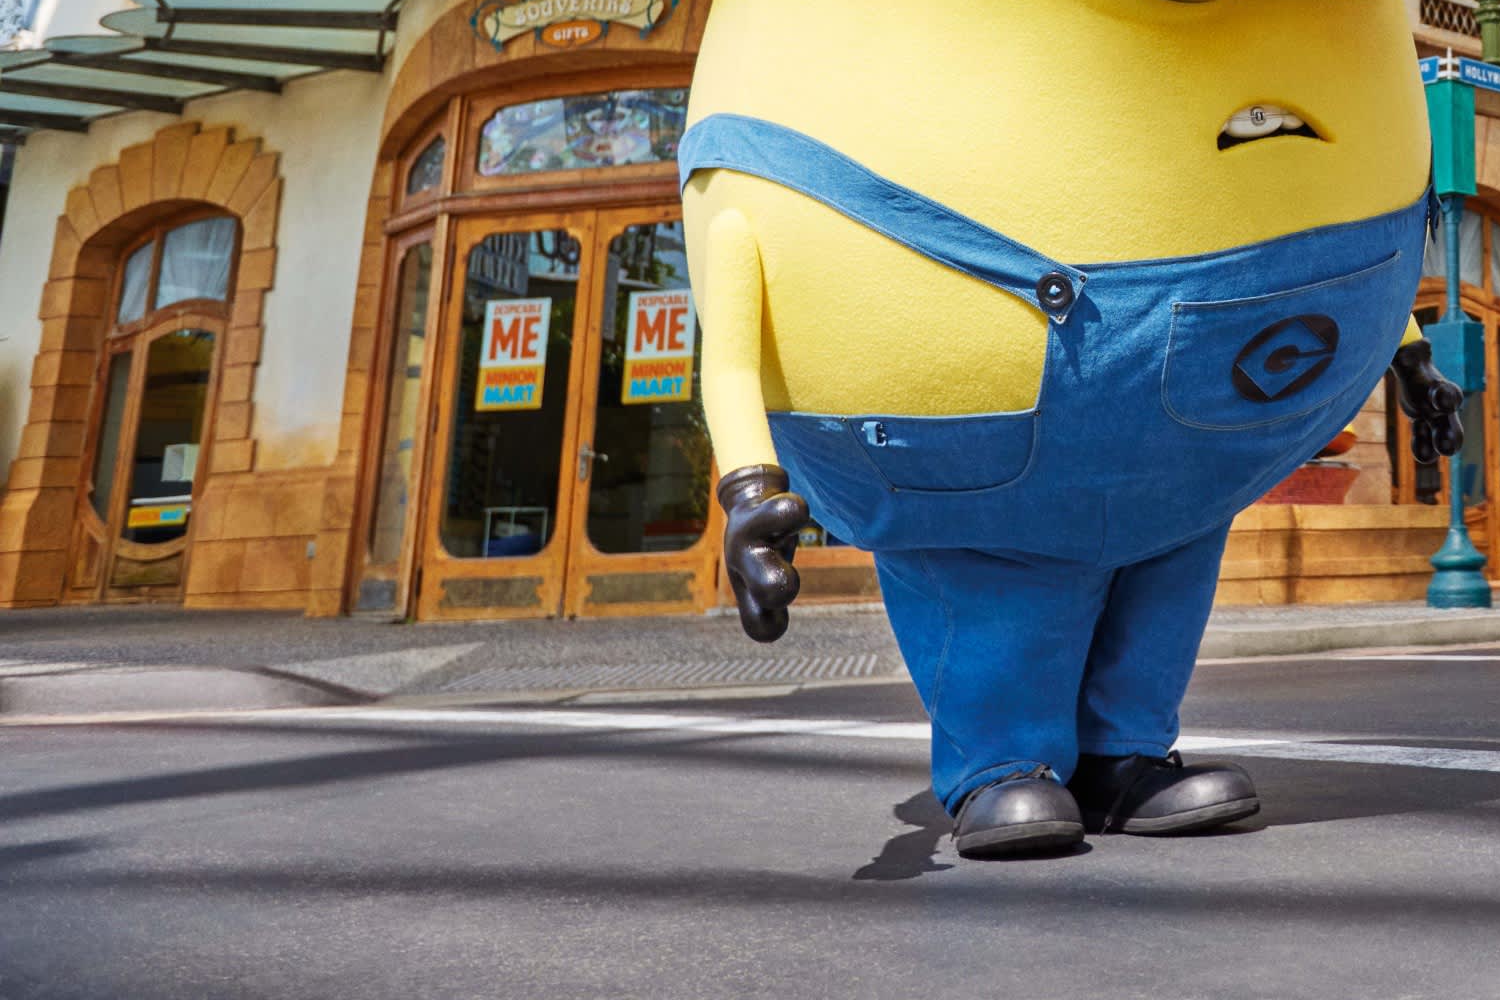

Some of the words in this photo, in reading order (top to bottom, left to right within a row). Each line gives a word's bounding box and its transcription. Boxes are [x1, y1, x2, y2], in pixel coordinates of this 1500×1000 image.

[553, 26, 590, 41] GIFTS
[488, 316, 542, 361] ME
[633, 307, 689, 353] ME
[485, 370, 536, 386] MINION
[631, 362, 685, 377] MINION
[483, 383, 536, 404] MART
[629, 376, 685, 397] MART
